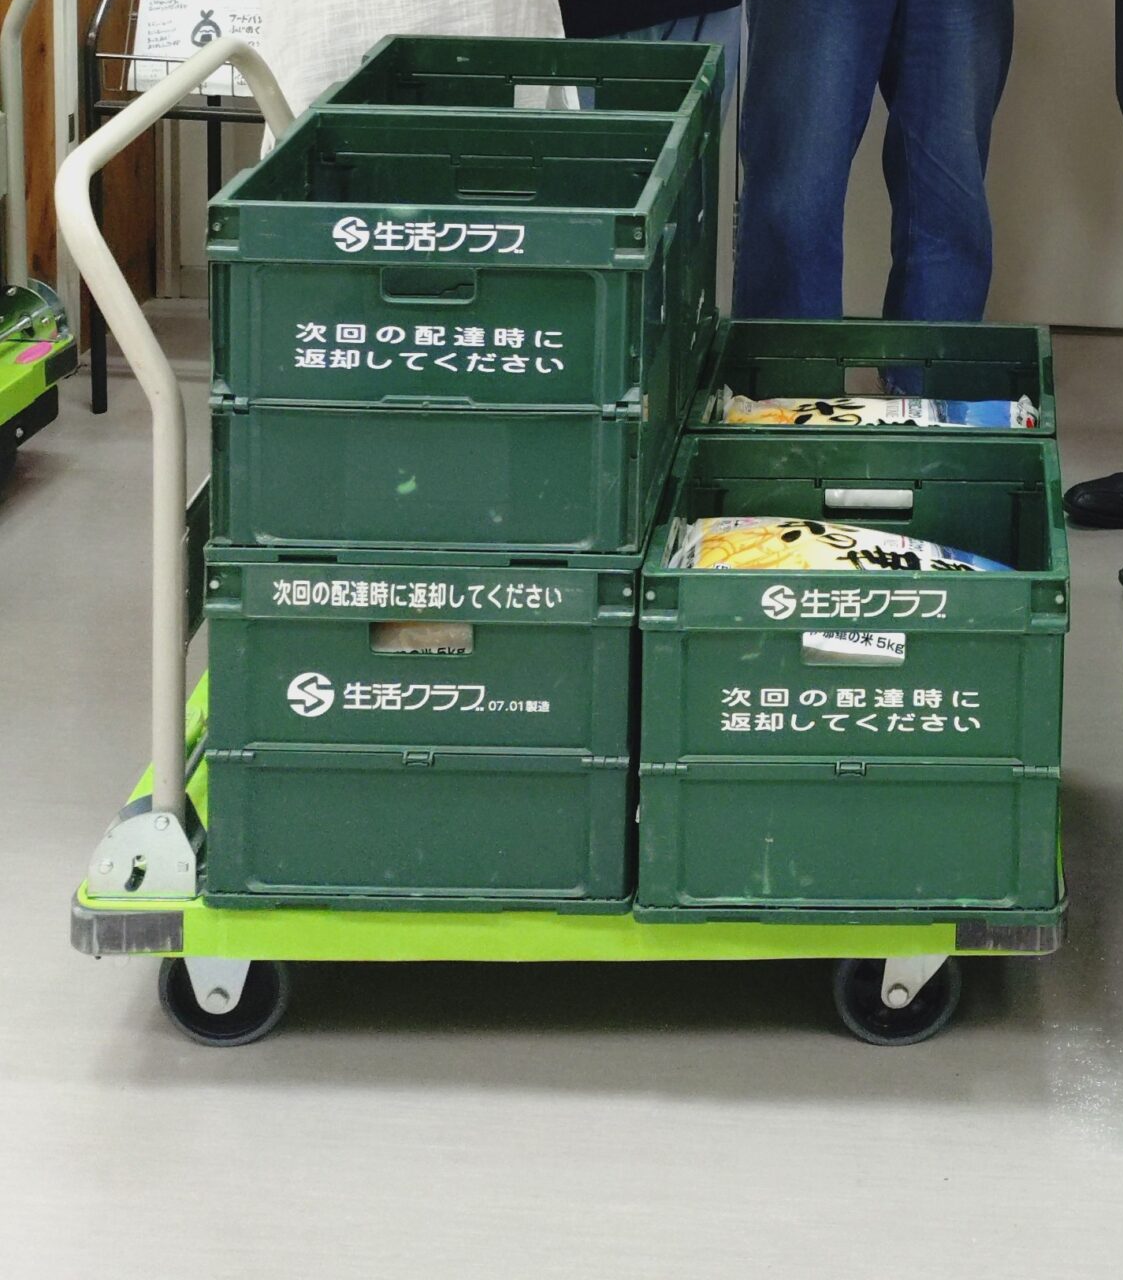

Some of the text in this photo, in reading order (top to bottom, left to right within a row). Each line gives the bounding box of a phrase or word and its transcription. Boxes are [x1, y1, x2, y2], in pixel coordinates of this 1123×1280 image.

[372, 220, 525, 254] 生活クラブ
[295, 322, 564, 349] 次回の配達時に
[294, 348, 565, 374] 返却してください
[272, 579, 563, 610] 次回の配達時に返却してください
[799, 588, 948, 619] 生活クラブ
[876, 636, 905, 654] 5kg
[343, 682, 550, 713] 生活クラブ 07.01製造
[721, 687, 980, 710] 次回の配達時に
[720, 712, 982, 733] 返却してください
